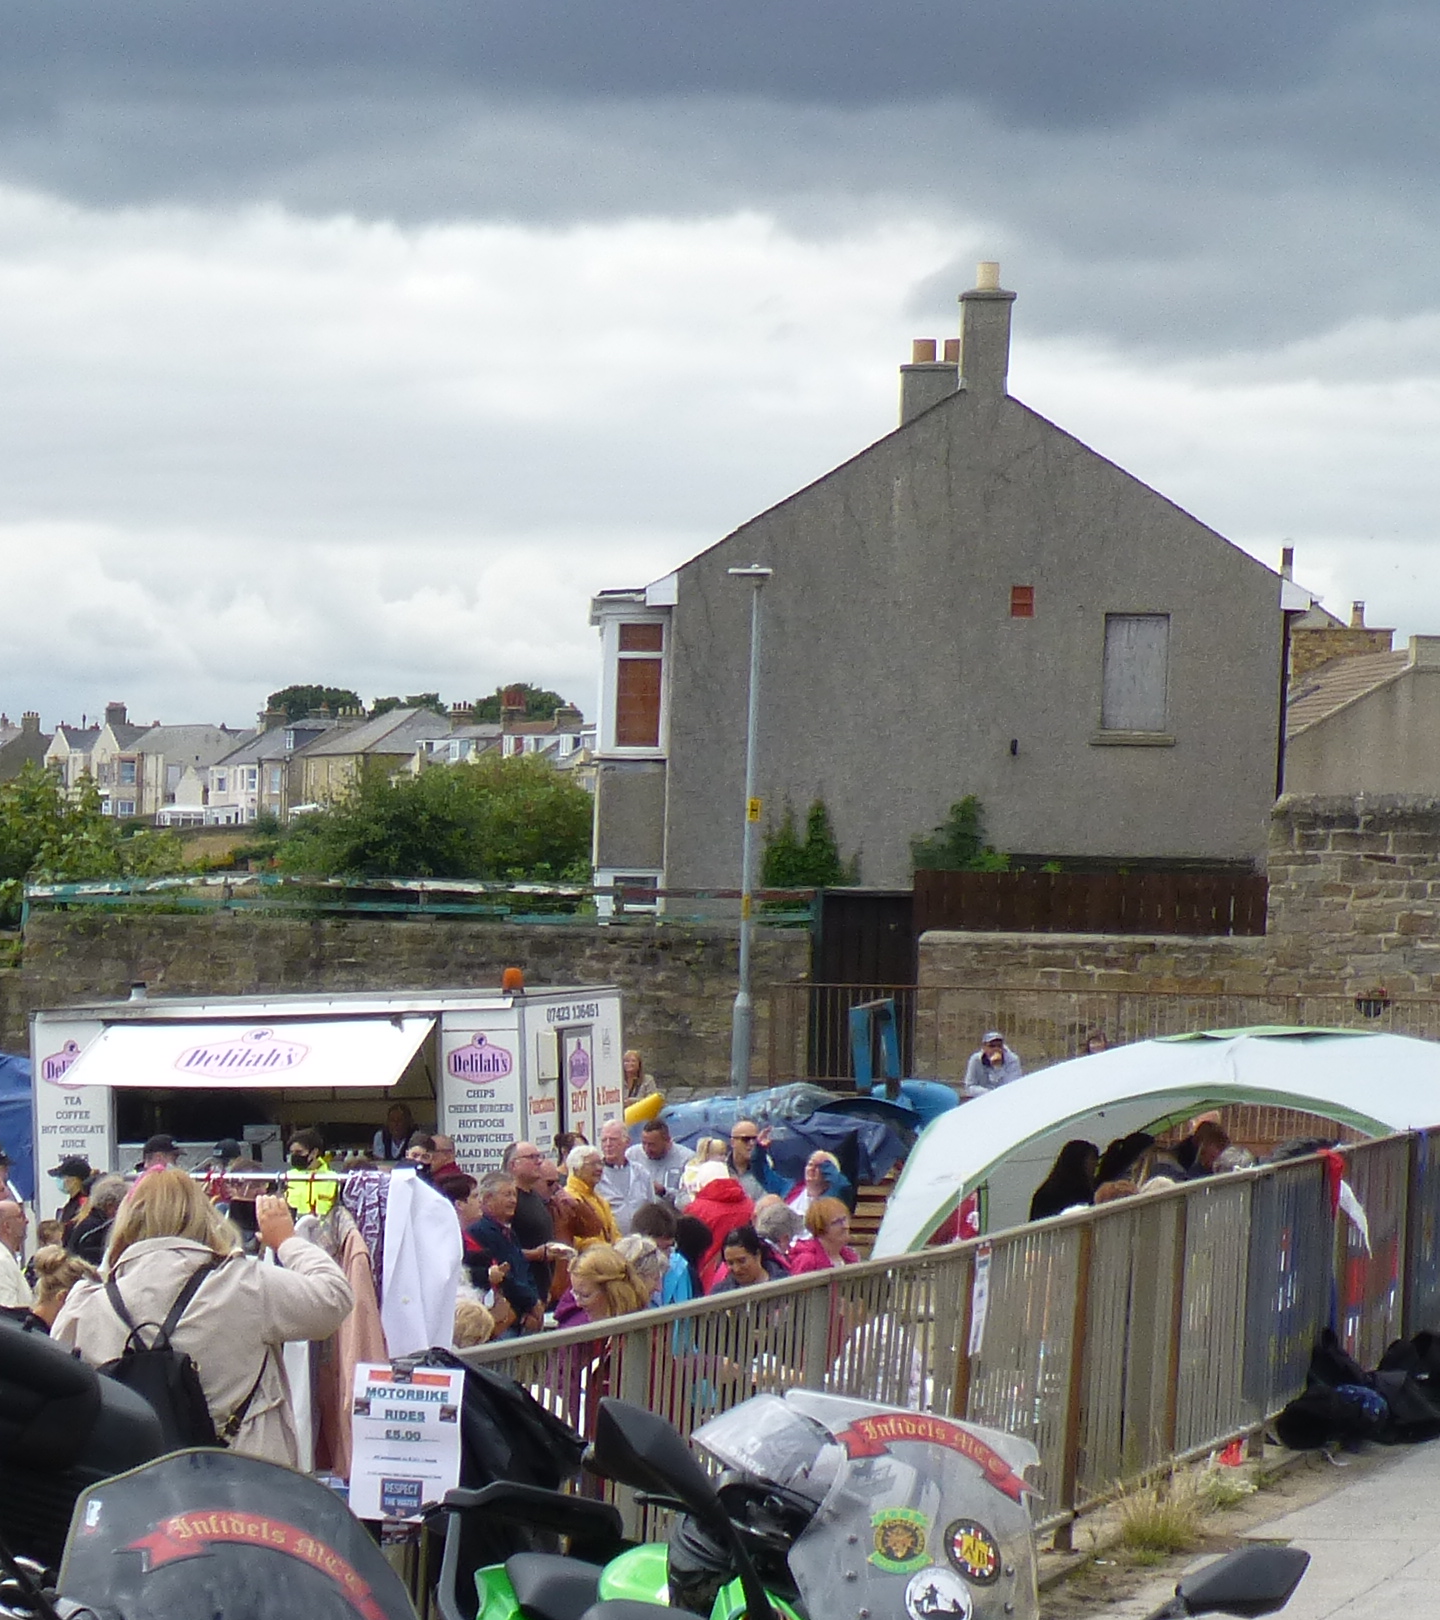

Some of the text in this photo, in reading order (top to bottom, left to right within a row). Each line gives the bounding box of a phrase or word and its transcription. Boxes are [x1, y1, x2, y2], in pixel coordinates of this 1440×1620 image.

[184, 1048, 298, 1069] Delilah's
[453, 1052, 508, 1073] Delilah's
[466, 1089, 495, 1098] CHIPS
[64, 1096, 82, 1106] TEA
[571, 1090, 588, 1113] HOT
[448, 1103, 514, 1113] CHEESE BURGERS
[55, 1110, 90, 1120] COFFEE
[458, 1118, 505, 1128] HOTDOGS
[41, 1124, 105, 1134] HOT CHOCOLATE
[60, 1138, 86, 1148] JUICE
[450, 1133, 514, 1143] SANDWICHES
[455, 1148, 481, 1158] ALAD
[365, 1386, 449, 1402] MOTORBIKE
[384, 1409, 426, 1422] RIDES
[385, 1429, 421, 1441] £5.00
[860, 1419, 946, 1440] Infidels
[384, 1482, 418, 1495] RESPECT
[170, 1516, 286, 1544] Infidels
